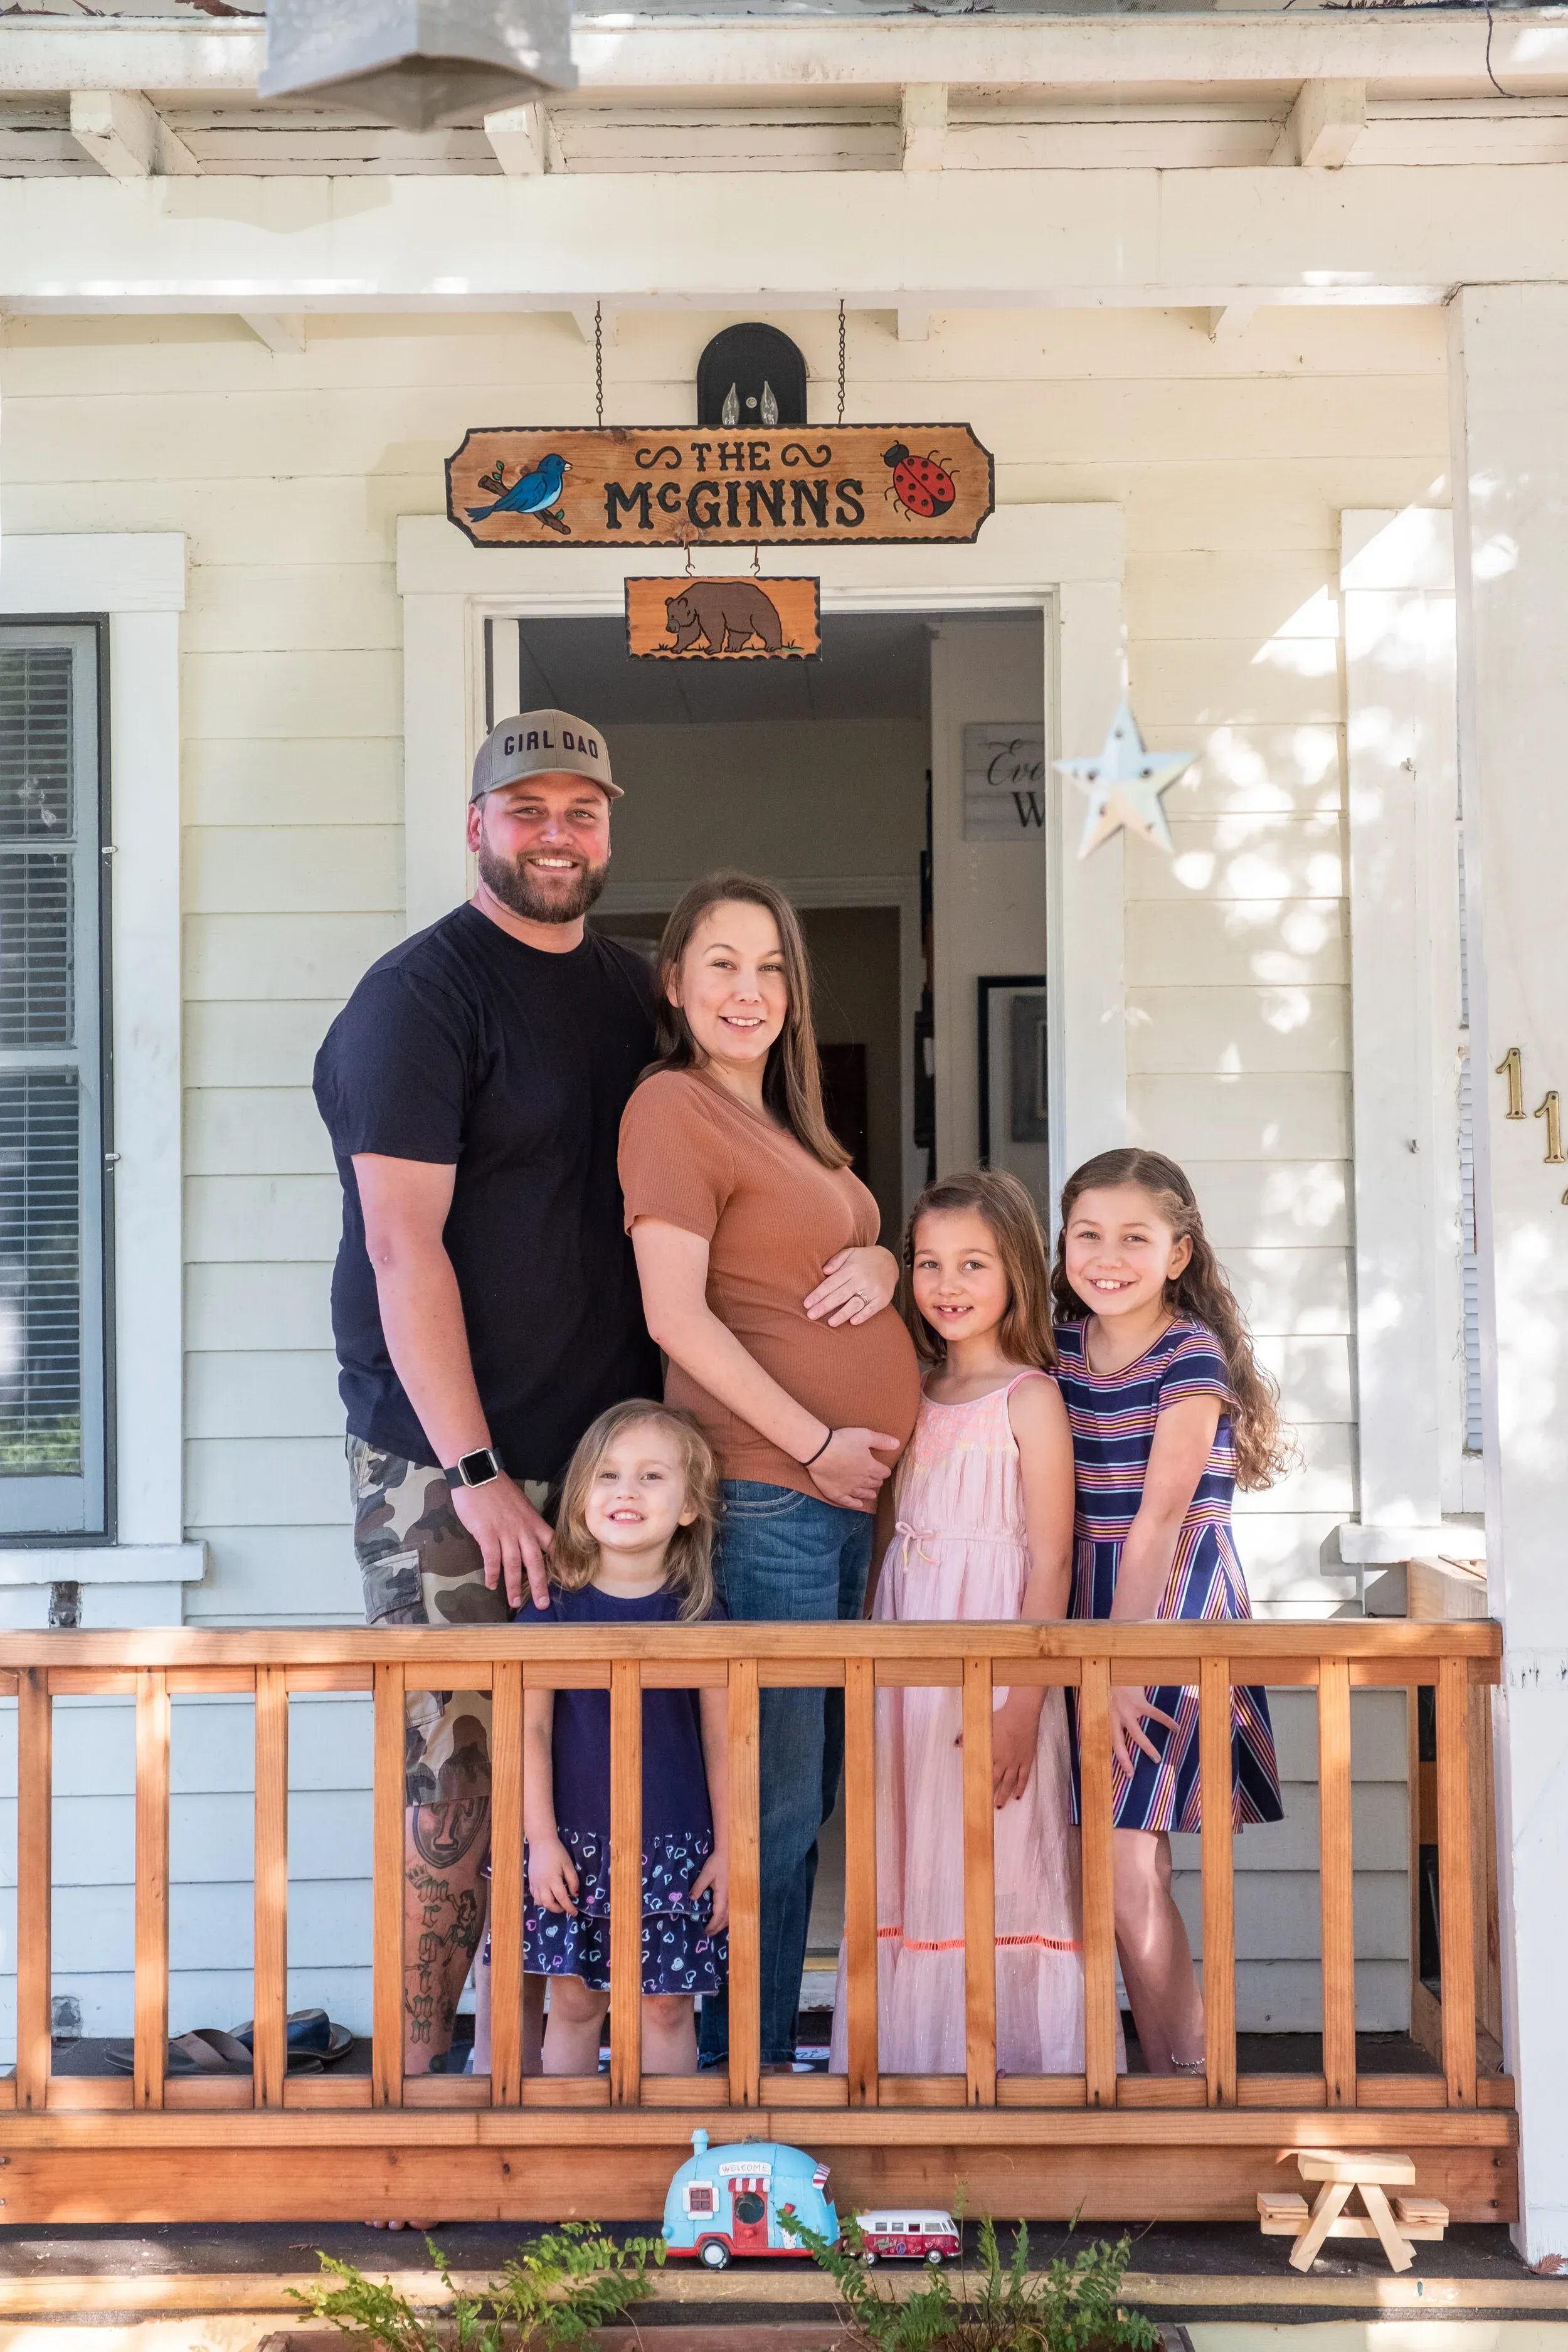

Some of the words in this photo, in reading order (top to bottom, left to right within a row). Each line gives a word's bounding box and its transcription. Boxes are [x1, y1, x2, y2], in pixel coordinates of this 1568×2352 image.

[691, 441, 771, 472] THE
[504, 730, 554, 756] GIRL
[563, 731, 598, 760] DAD
[721, 2164, 768, 2173] WELCOME
